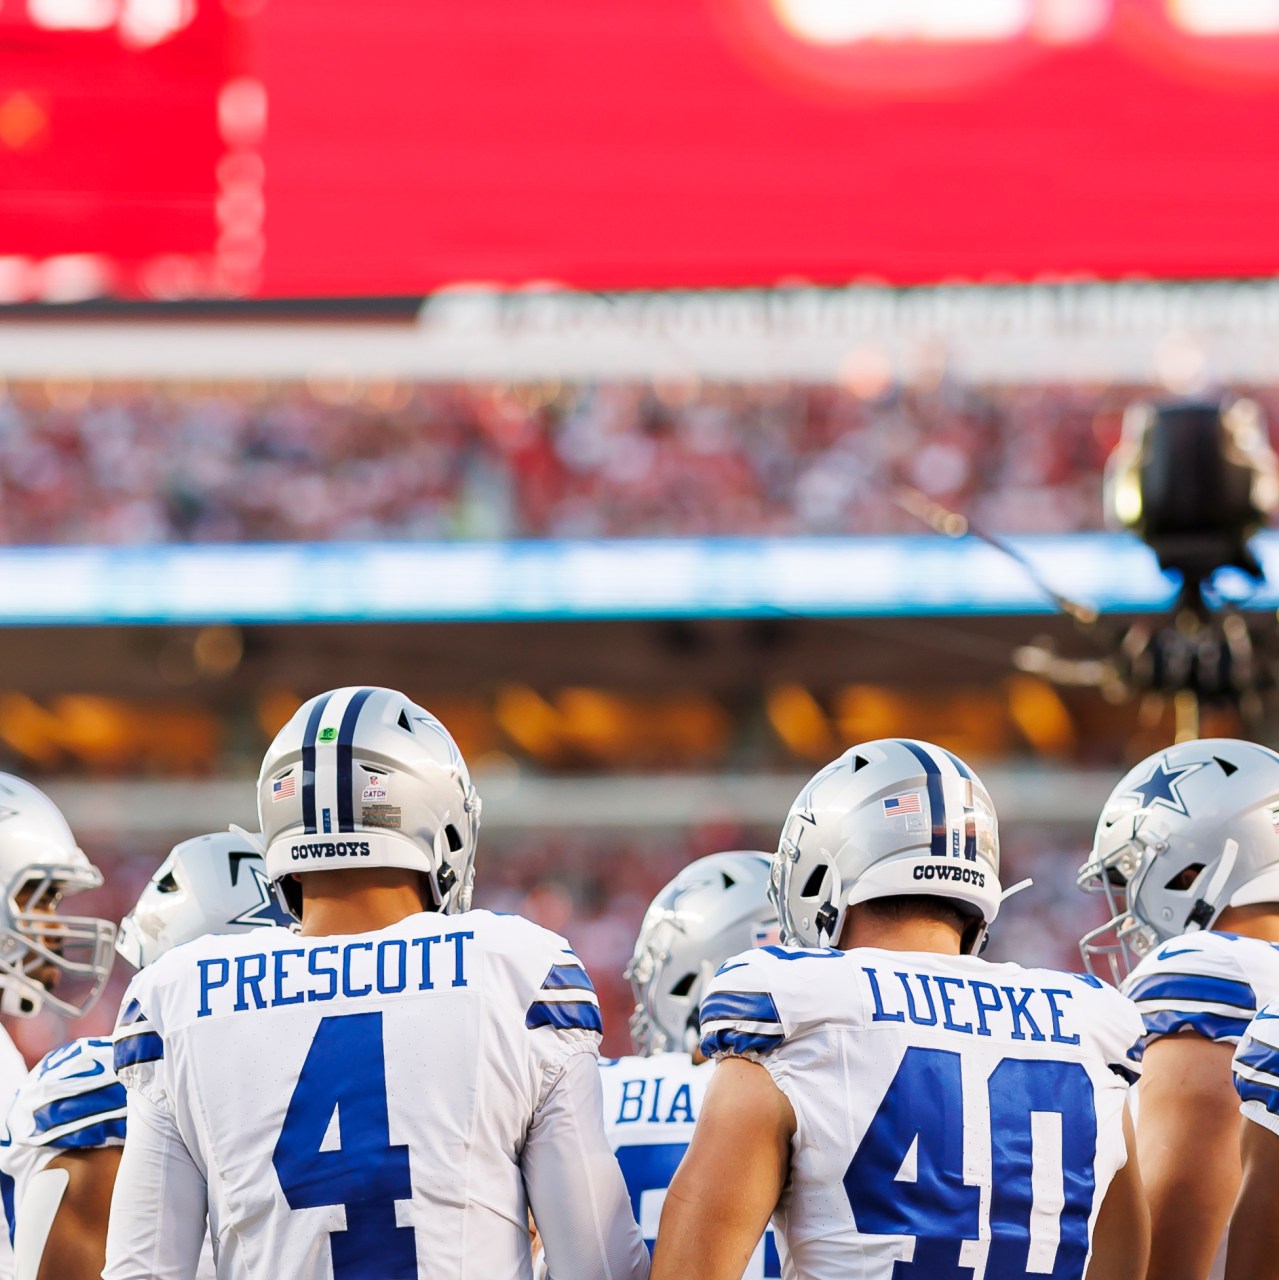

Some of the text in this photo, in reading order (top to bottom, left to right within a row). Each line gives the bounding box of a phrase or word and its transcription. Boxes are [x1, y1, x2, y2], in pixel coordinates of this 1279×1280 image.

[363, 790, 386, 798] CATCH
[291, 841, 370, 860] COWBOYS
[913, 864, 985, 888] COWBOYS
[197, 931, 474, 1018] PRESCOTT
[861, 967, 1081, 1047] LUEPKE
